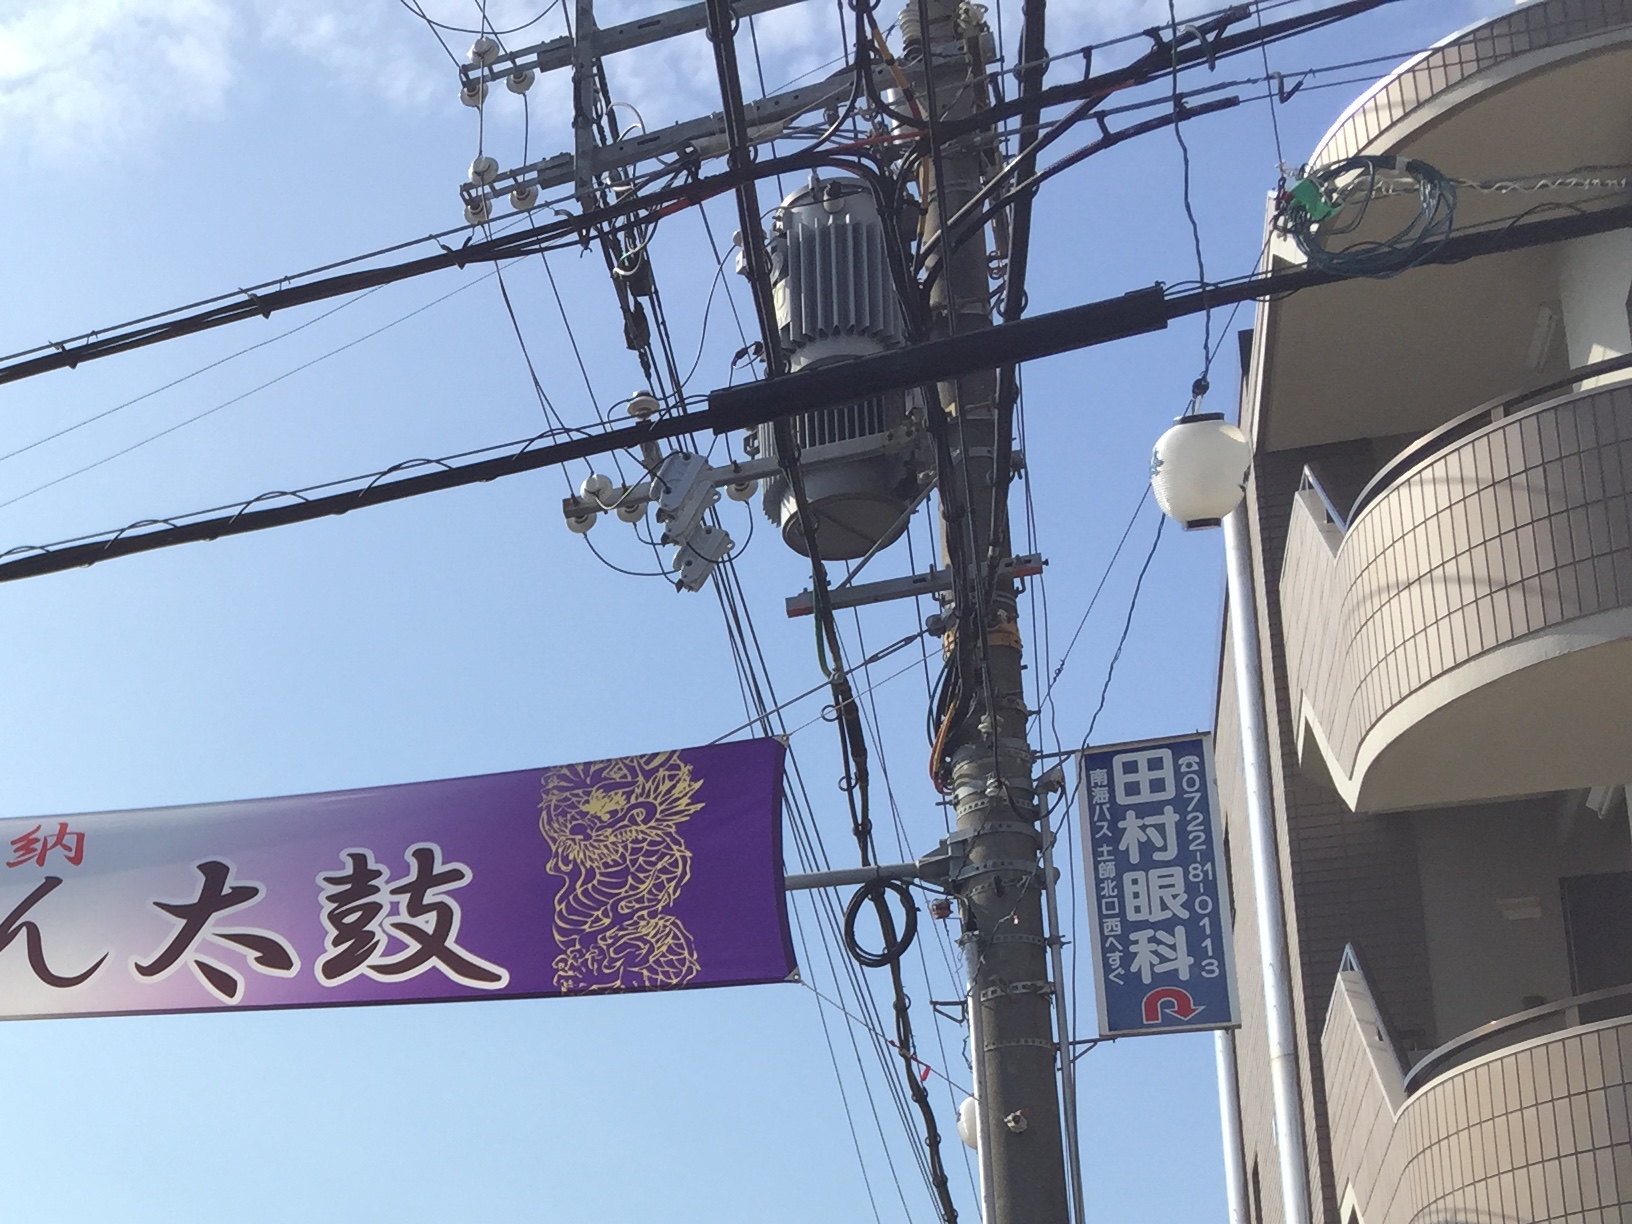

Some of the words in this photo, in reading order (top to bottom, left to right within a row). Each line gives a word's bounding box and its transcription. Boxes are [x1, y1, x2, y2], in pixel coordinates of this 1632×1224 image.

[5, 823, 86, 869] 納
[1089, 768, 1113, 838] 南海バス
[1096, 844, 1125, 986] 土師北口西へすぐ
[1112, 747, 1195, 985] 田村眼科
